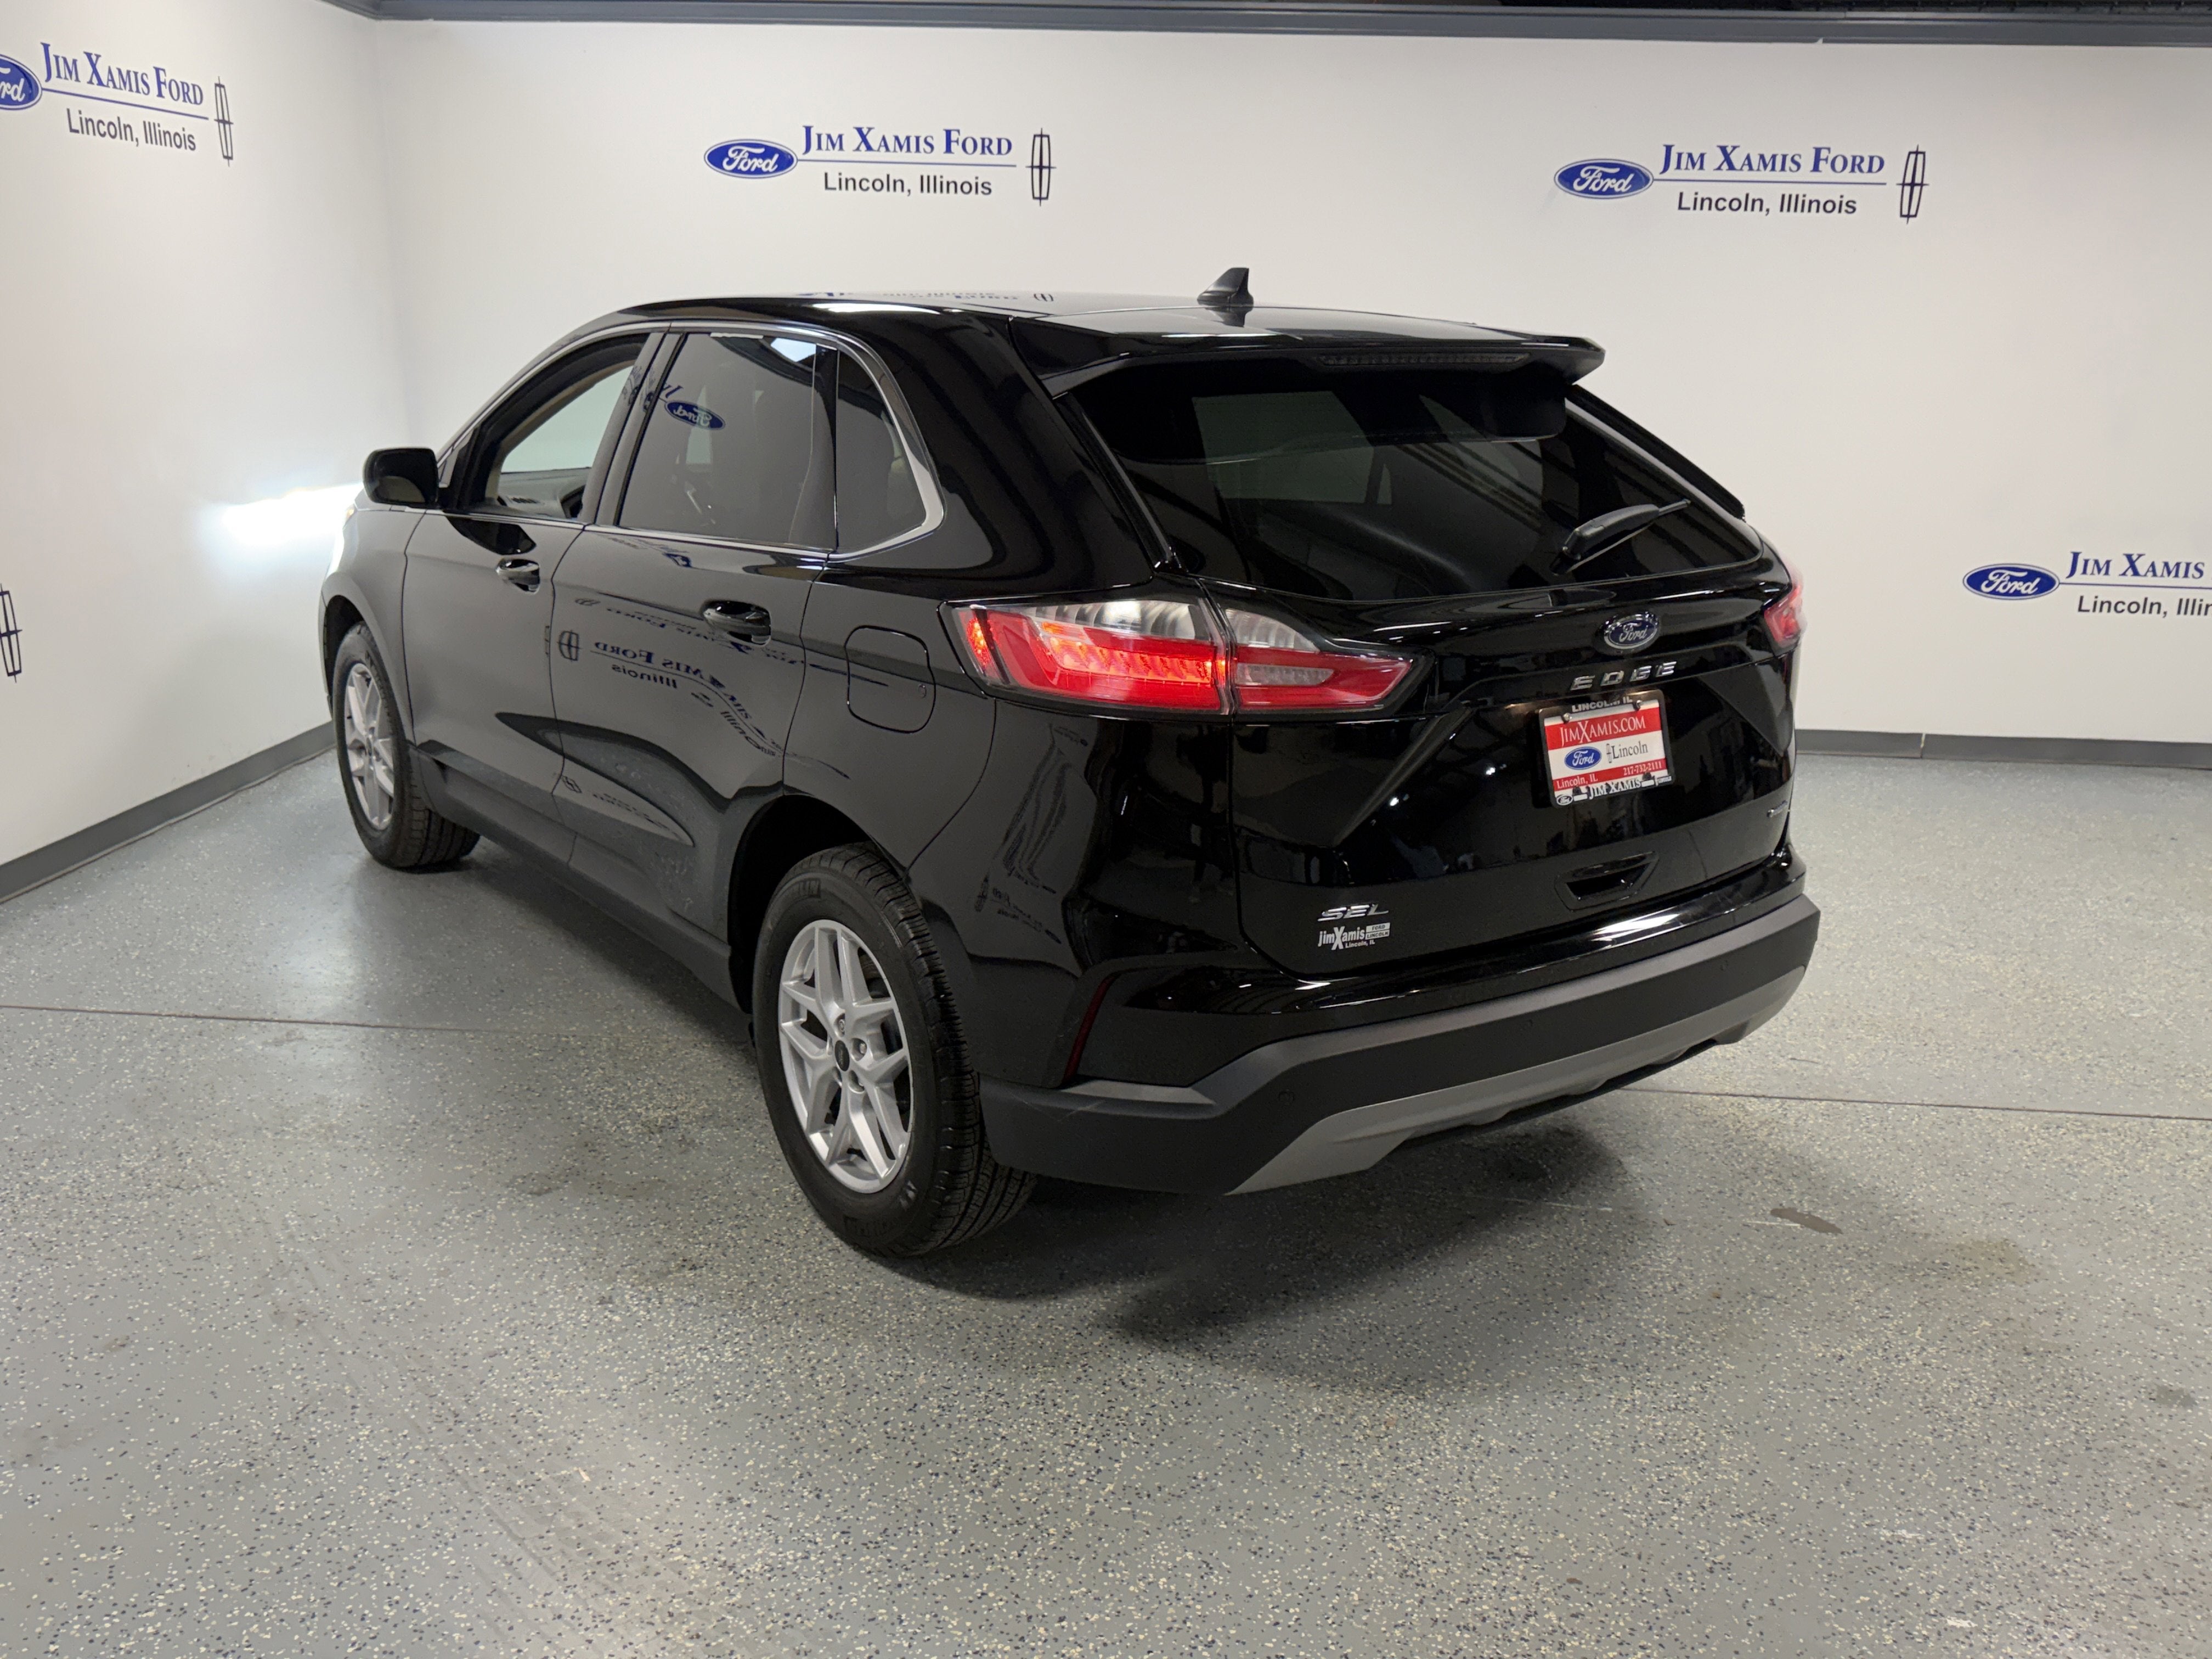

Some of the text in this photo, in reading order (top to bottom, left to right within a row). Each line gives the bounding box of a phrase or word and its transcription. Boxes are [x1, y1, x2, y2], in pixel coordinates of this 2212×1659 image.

[0, 67, 25, 101] rd
[41, 42, 204, 105] JIM XAMIS FORD
[66, 108, 196, 151] Lincoln, Illinois
[802, 126, 1012, 156] JIM XAMIS FORD
[722, 145, 778, 172] Ford
[1660, 144, 1885, 174] JIM XAMIS FORD
[824, 172, 992, 196] Lincoln, Illinois
[1572, 165, 1632, 193] Ford
[1678, 192, 1857, 216] Lincoln, Illinois
[2066, 551, 2205, 579] JIM XAMIS
[1980, 569, 2040, 595] Ford
[2077, 595, 2168, 618] Lincoln,
[1620, 622, 1648, 642] Ford
[1570, 661, 1677, 691] EDGE
[1560, 715, 1646, 747] JIMXAMIS.COM
[1572, 749, 1595, 766] Ford
[1611, 740, 1649, 759] Lincoln
[1556, 776, 1588, 789] Lincoln,
[1589, 783, 1609, 800] JIM
[1609, 778, 1642, 794] XAMIS
[1317, 904, 1389, 922] SEL
